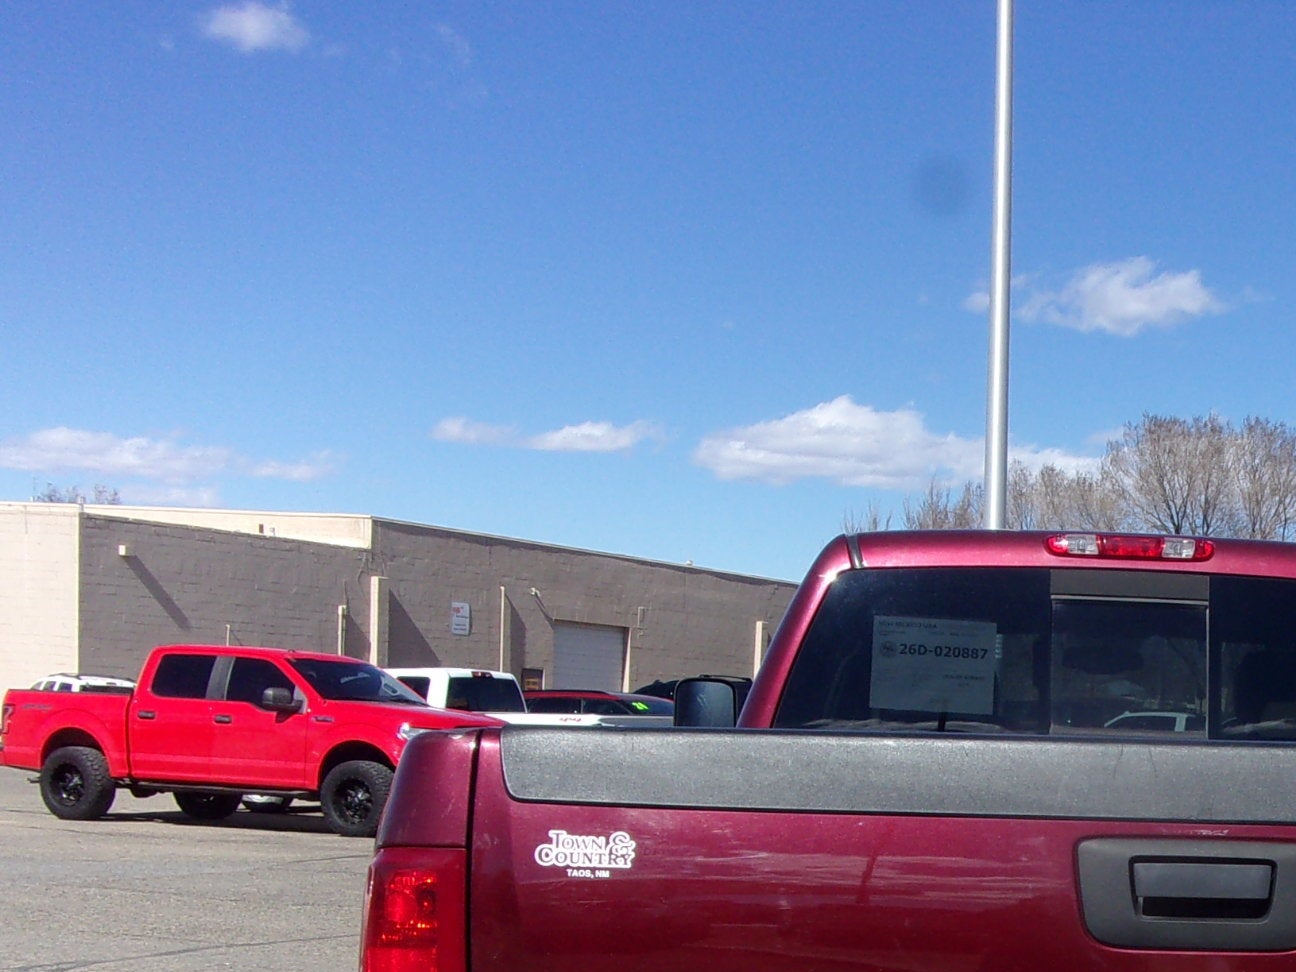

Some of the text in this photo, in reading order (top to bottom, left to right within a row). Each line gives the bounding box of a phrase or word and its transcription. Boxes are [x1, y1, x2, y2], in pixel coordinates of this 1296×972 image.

[899, 643, 989, 660] 26D-020887
[606, 831, 636, 860] &
[535, 844, 632, 868] COUNTRY
[566, 868, 610, 878] TAOS, NM
